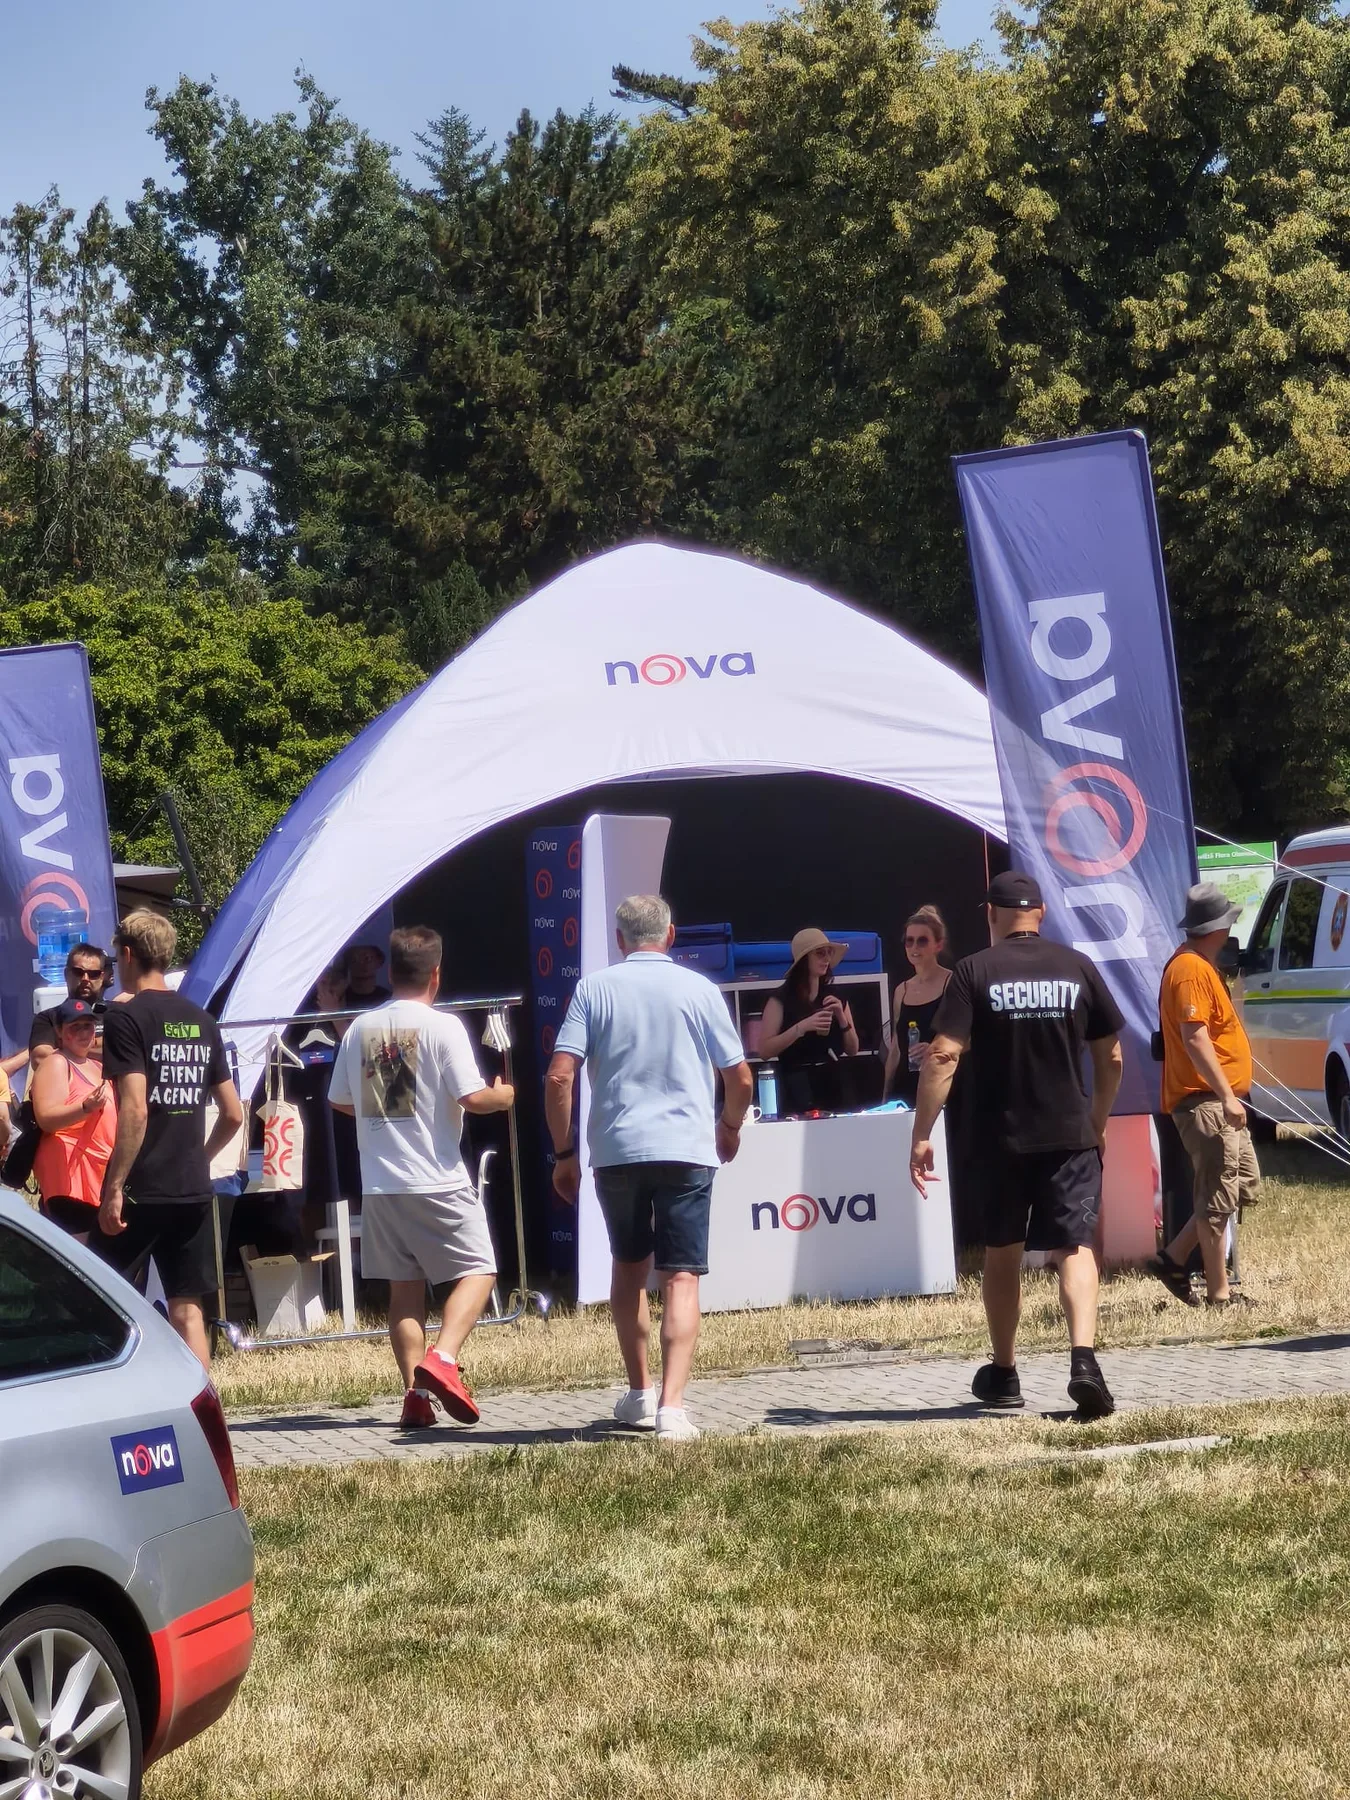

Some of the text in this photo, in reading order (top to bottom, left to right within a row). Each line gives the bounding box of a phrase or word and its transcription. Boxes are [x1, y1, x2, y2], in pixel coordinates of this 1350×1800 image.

[604, 651, 756, 686] nova
[1028, 591, 1148, 963] nova
[532, 840, 558, 852] nova
[8, 753, 90, 974] ova
[534, 917, 555, 929] nova
[561, 965, 580, 977] nova
[537, 995, 557, 1007] nova
[989, 980, 1080, 1012] SECURITY
[151, 1043, 212, 1064] CREATIVE
[159, 1065, 205, 1084] EVENT
[149, 1085, 203, 1105] AGENC
[751, 1193, 877, 1232] nova
[121, 1443, 175, 1477] nova
